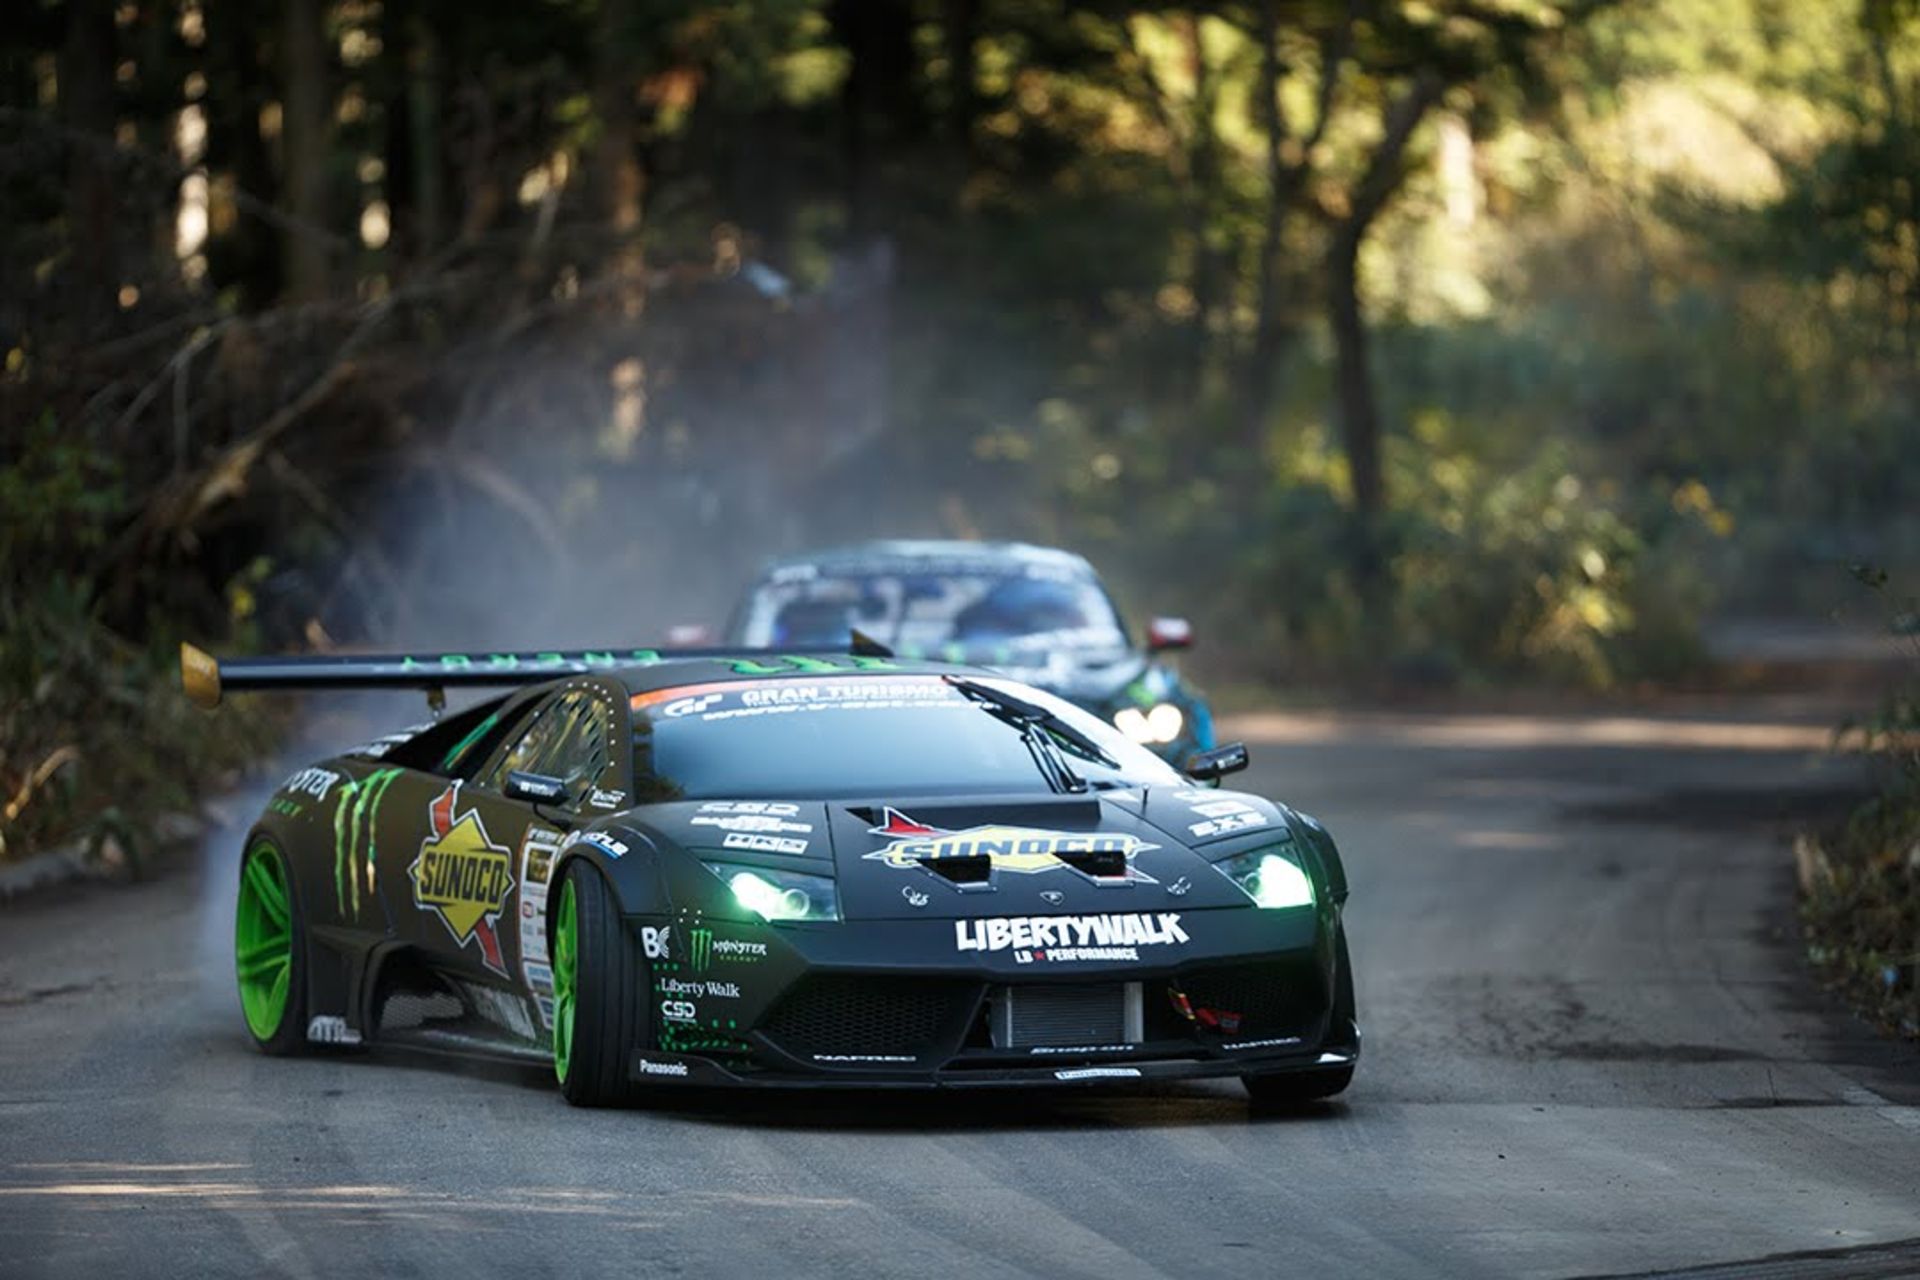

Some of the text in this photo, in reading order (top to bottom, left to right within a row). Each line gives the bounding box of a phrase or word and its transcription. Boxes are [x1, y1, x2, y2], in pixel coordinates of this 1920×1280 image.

[741, 685, 818, 703] GRAN
[826, 684, 951, 700] TURISMO
[901, 838, 1128, 859] SUNOCO
[420, 851, 506, 905] SUNOCO
[954, 912, 1190, 951] LIBERTYWALK
[712, 940, 768, 956] MONSTER
[1014, 947, 1140, 964] LB PERFORMANCE
[661, 977, 741, 998] Liberty Walk
[640, 1059, 688, 1076] Panasonic
